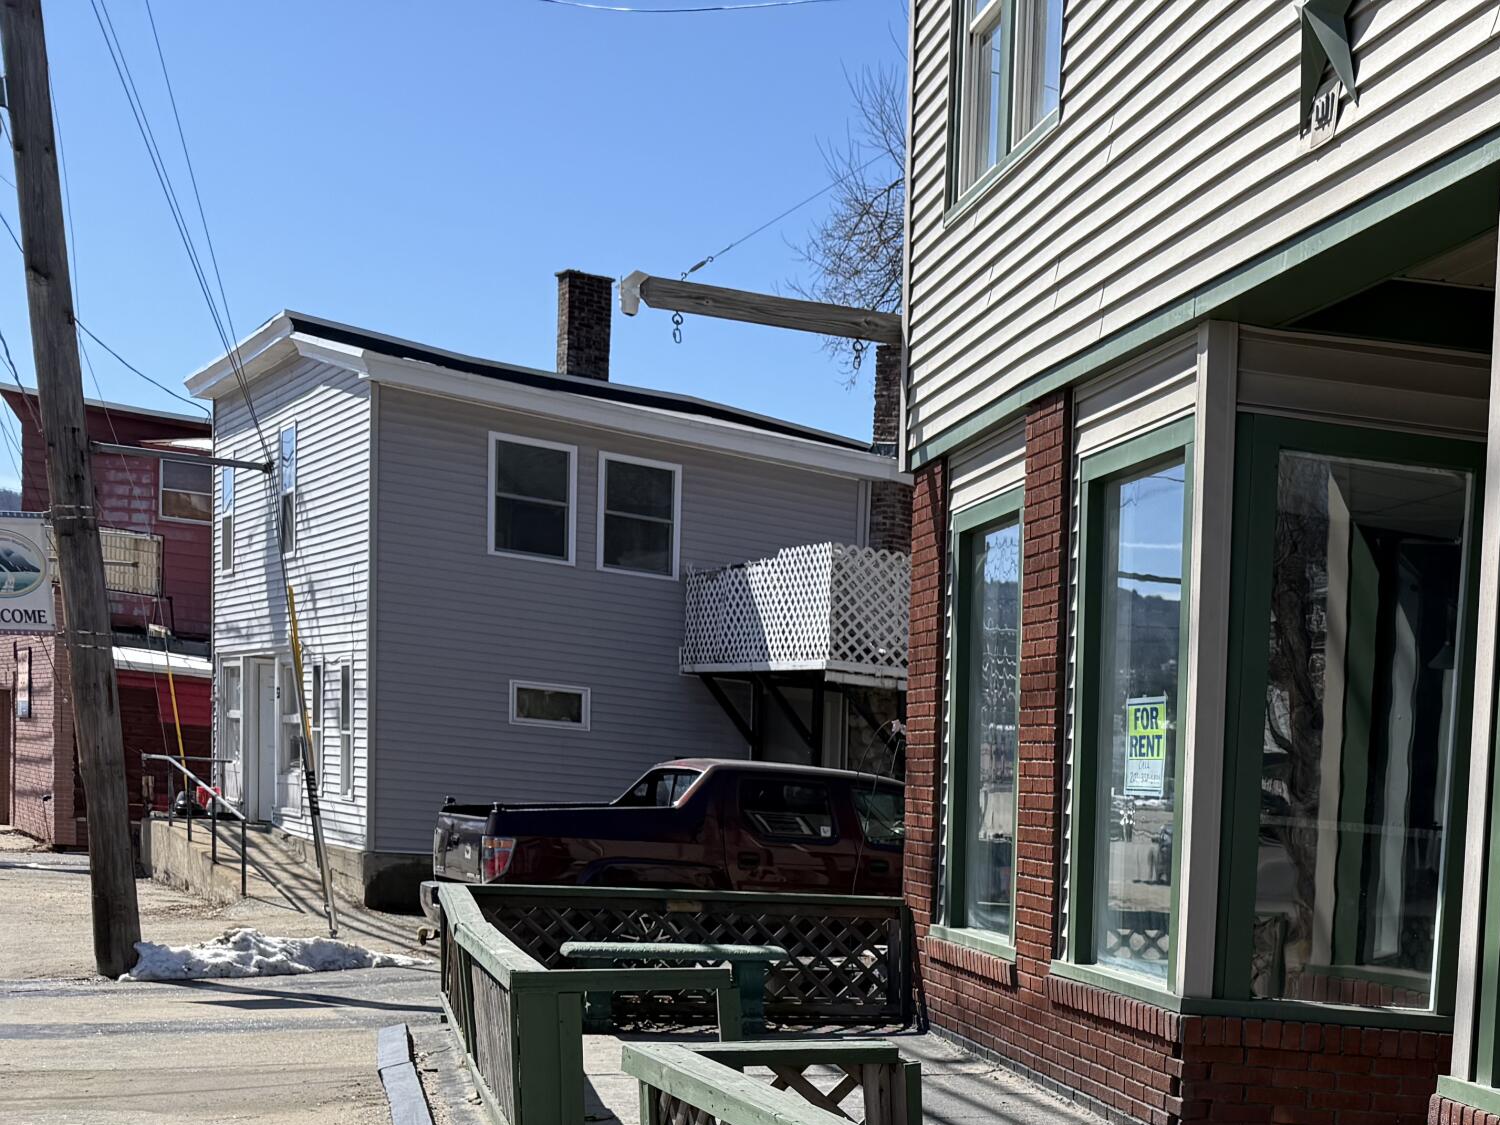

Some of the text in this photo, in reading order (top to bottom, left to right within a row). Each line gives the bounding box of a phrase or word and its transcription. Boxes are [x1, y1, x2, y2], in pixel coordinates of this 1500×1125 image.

[0, 608, 48, 624] COME
[1134, 706, 1159, 731] FOR
[1129, 735, 1162, 758] RENT
